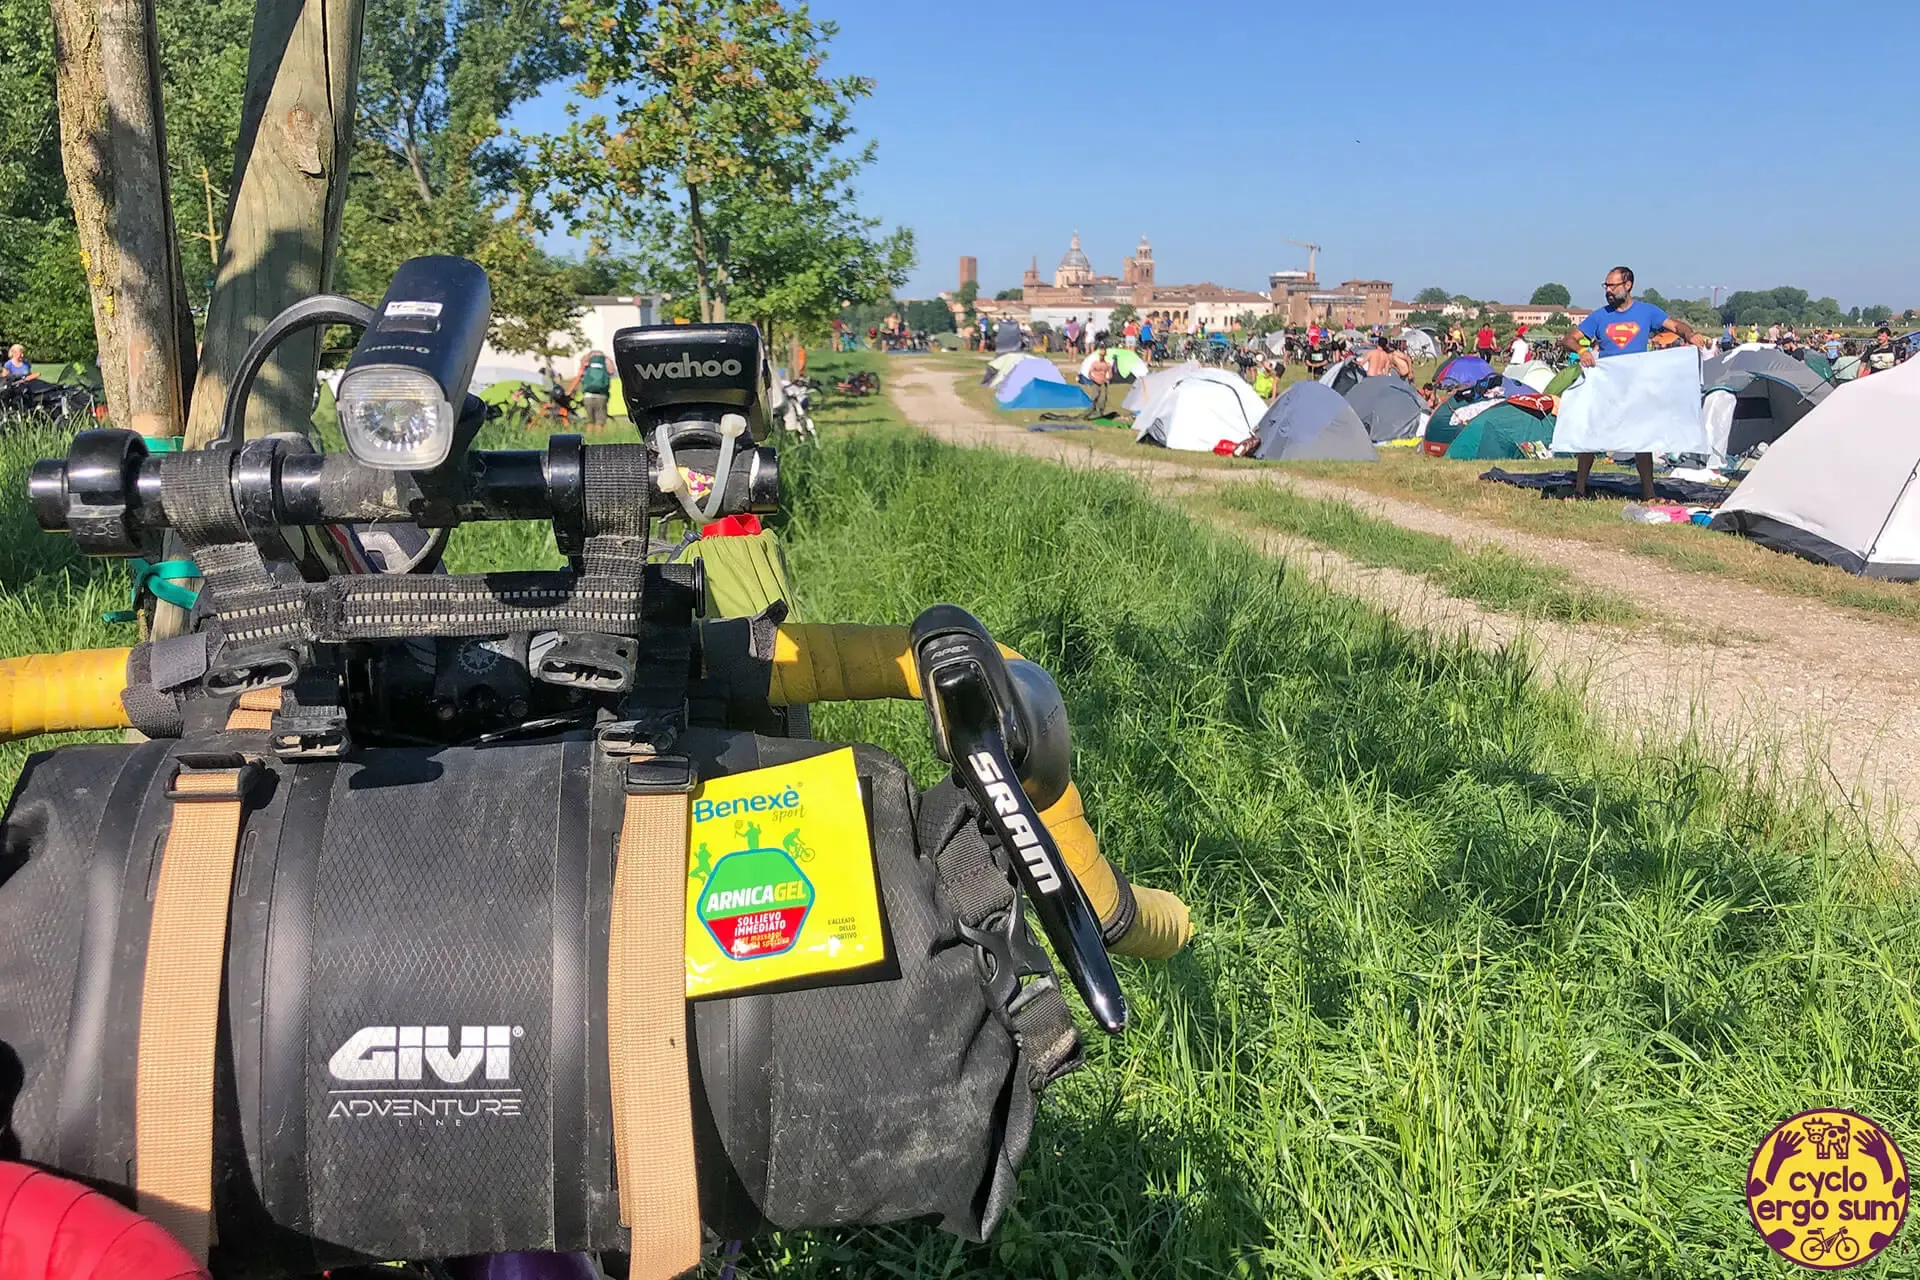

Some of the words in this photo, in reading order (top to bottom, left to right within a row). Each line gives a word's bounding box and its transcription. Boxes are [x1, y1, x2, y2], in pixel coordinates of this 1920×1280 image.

[634, 352, 742, 380] wahoo
[692, 784, 799, 823] Benexè
[968, 751, 1061, 894] SRAM
[734, 920, 786, 936] IMMEDIATO
[737, 911, 781, 927] SOLLIEVO
[328, 1026, 511, 1083] GIVI
[328, 1099, 521, 1118] ADVENTURE
[399, 1119, 461, 1127] LINE
